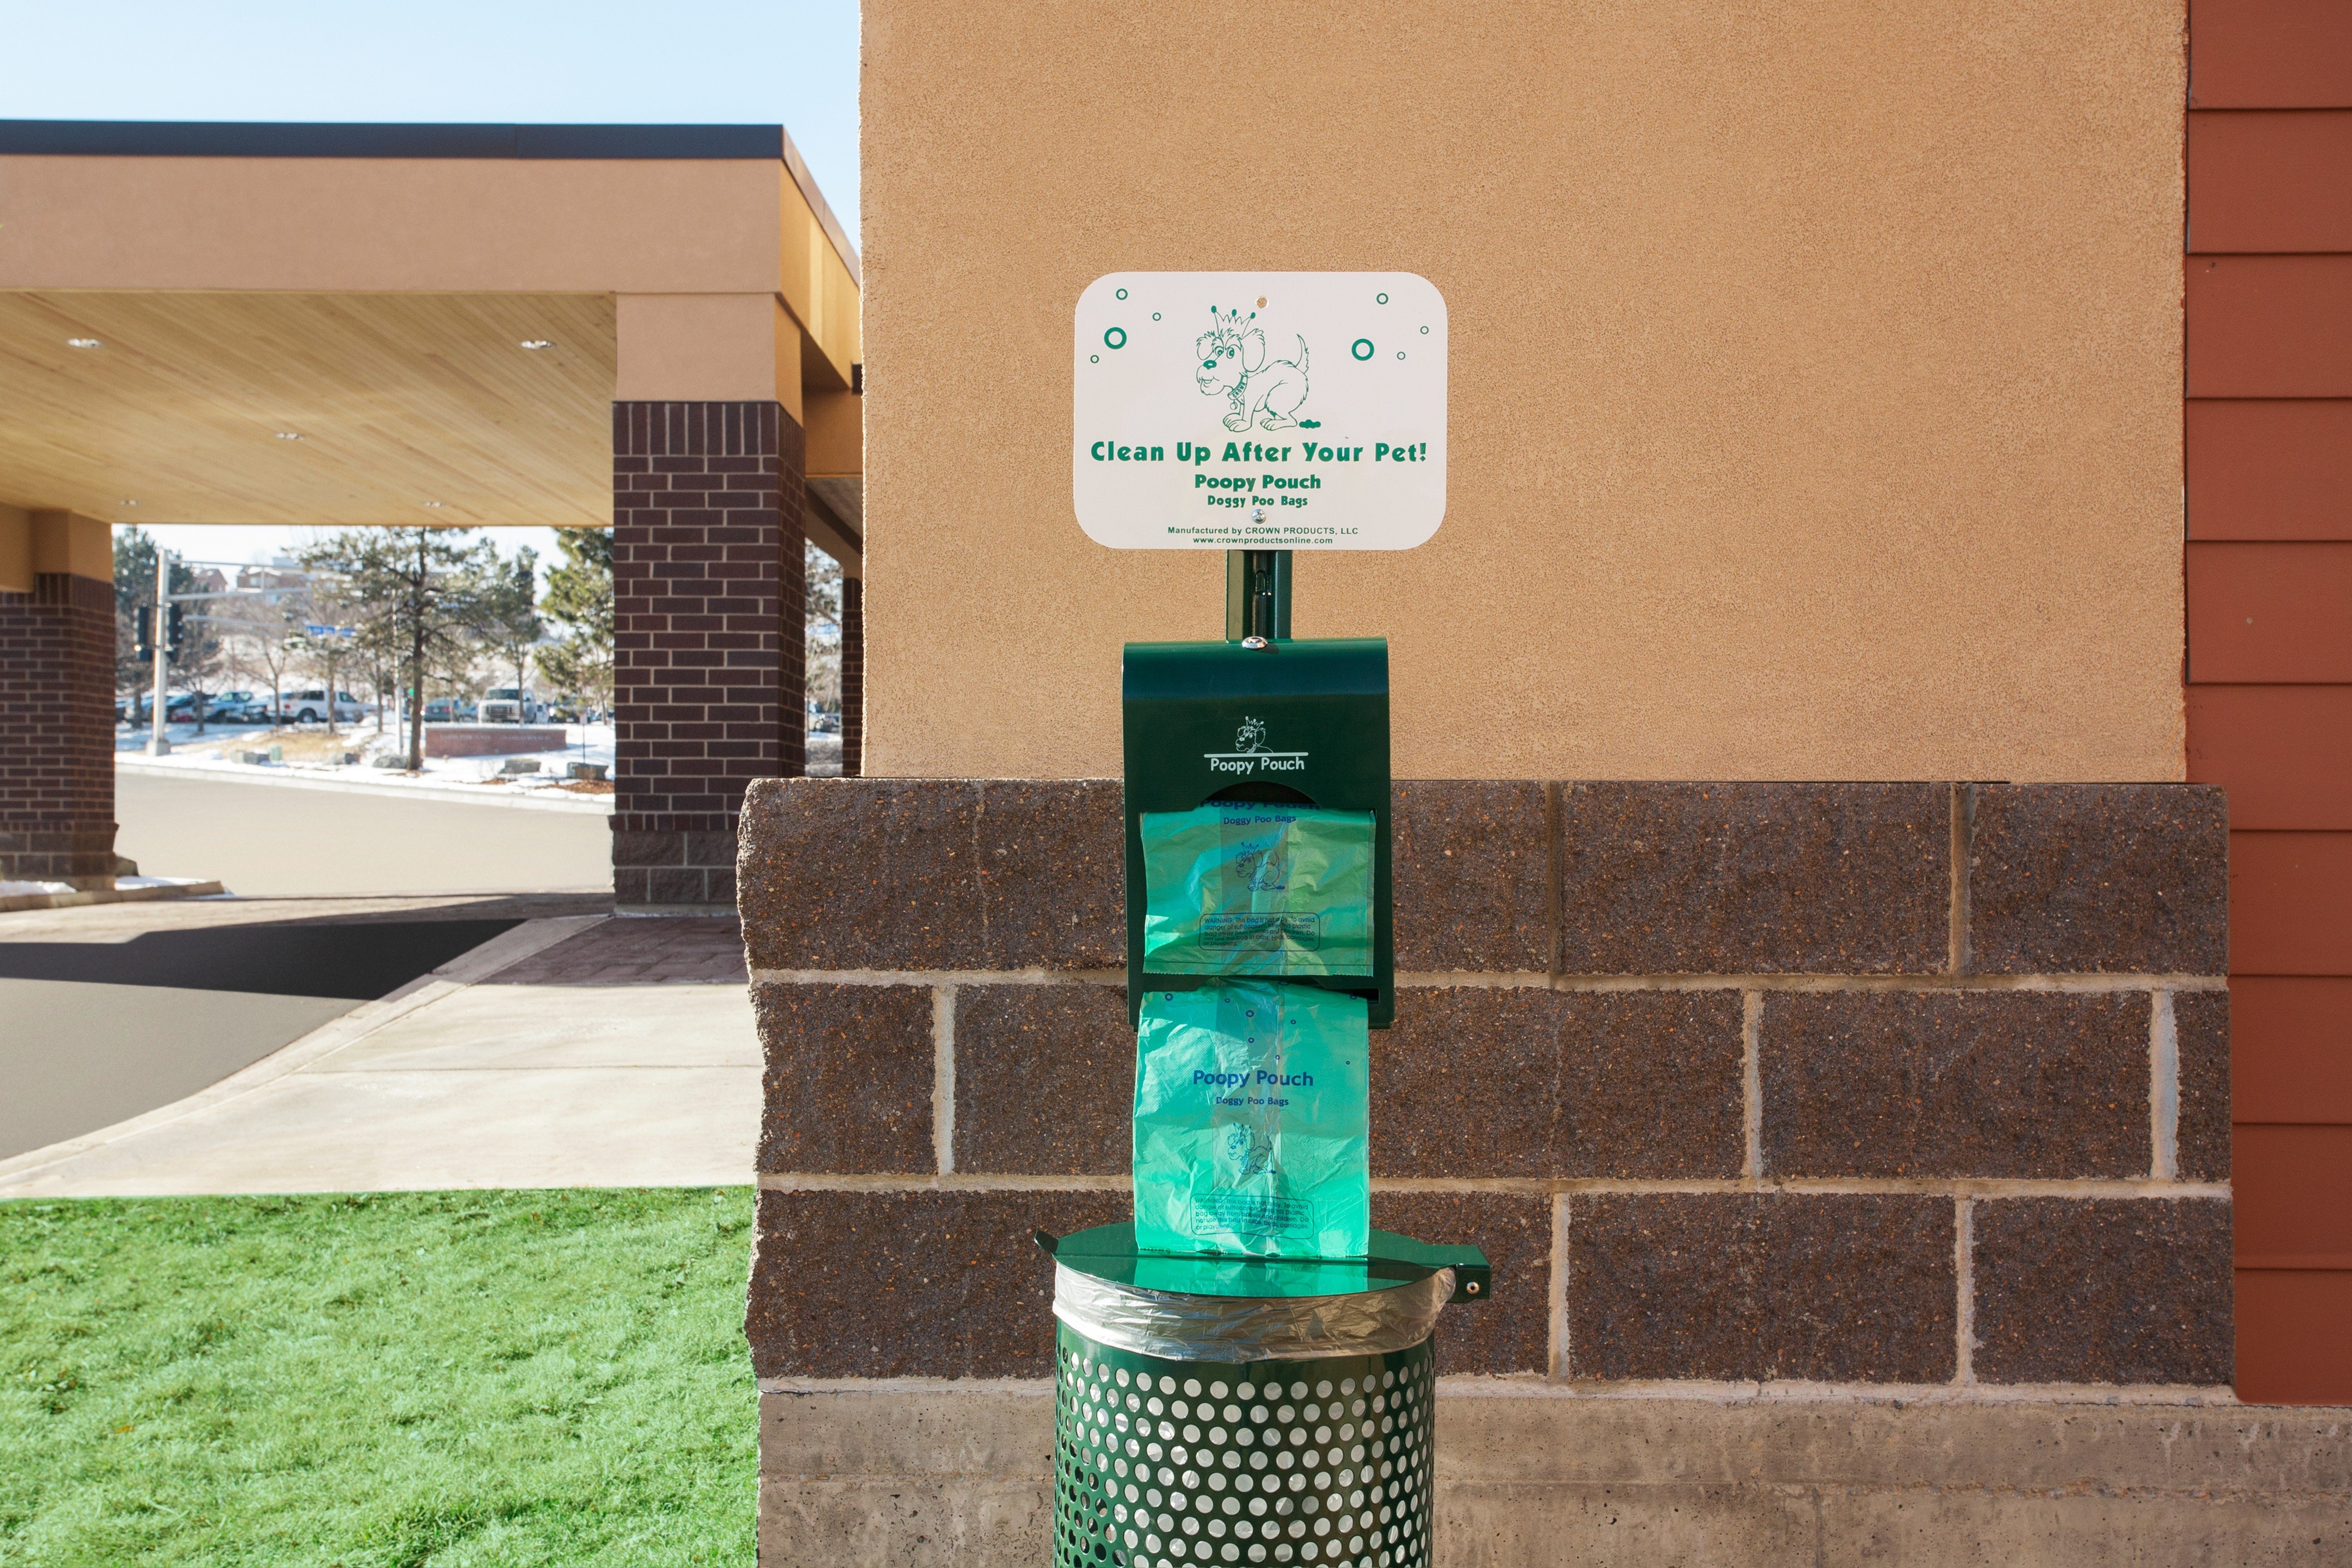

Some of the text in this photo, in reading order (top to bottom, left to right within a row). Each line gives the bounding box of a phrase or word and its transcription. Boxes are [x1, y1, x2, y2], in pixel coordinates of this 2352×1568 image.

[1091, 441, 1426, 466] Clean Up After Your Pet!
[1195, 474, 1321, 492] Poopy Pouch
[1207, 495, 1308, 509] Doggy Poo Bags
[1232, 527, 1242, 536] by
[1210, 756, 1305, 775] Poopy Pouch
[1223, 816, 1251, 825] Doggy
[1193, 1070, 1313, 1088] Poopy Pouch
[1216, 1097, 1244, 1105] Doggy
[1267, 1097, 1289, 1106] Bags
